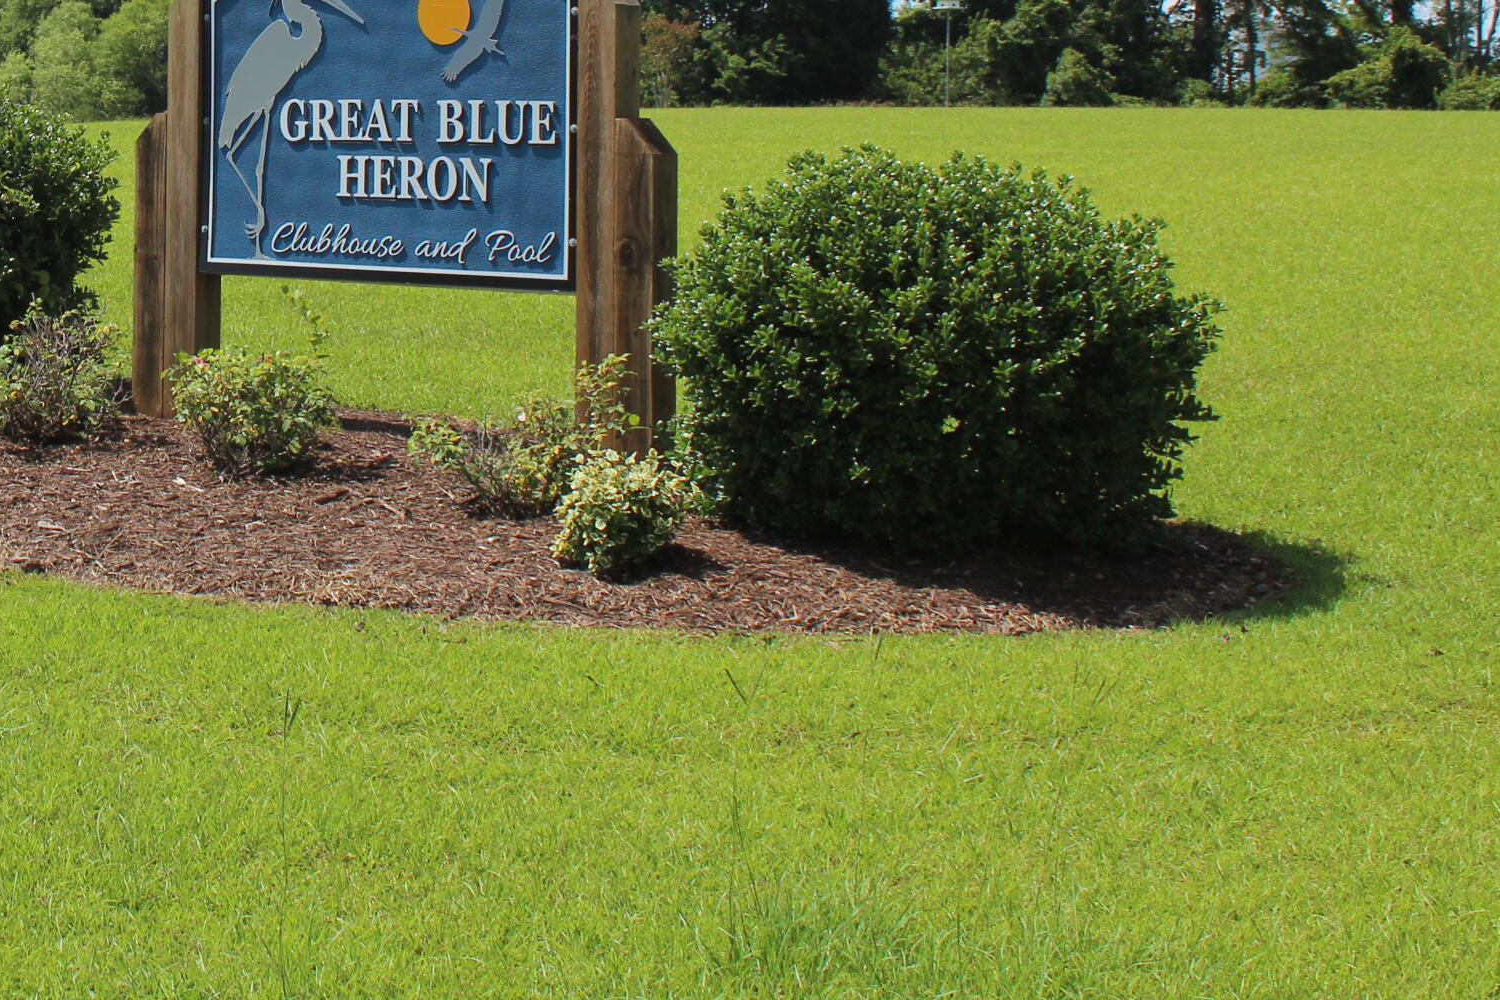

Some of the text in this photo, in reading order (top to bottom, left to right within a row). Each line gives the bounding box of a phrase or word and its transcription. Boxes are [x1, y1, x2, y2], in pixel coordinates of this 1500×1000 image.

[279, 98, 556, 145] GREAT BLUE
[336, 155, 492, 202] HERON
[271, 222, 556, 264] Clubhouse and Pool
